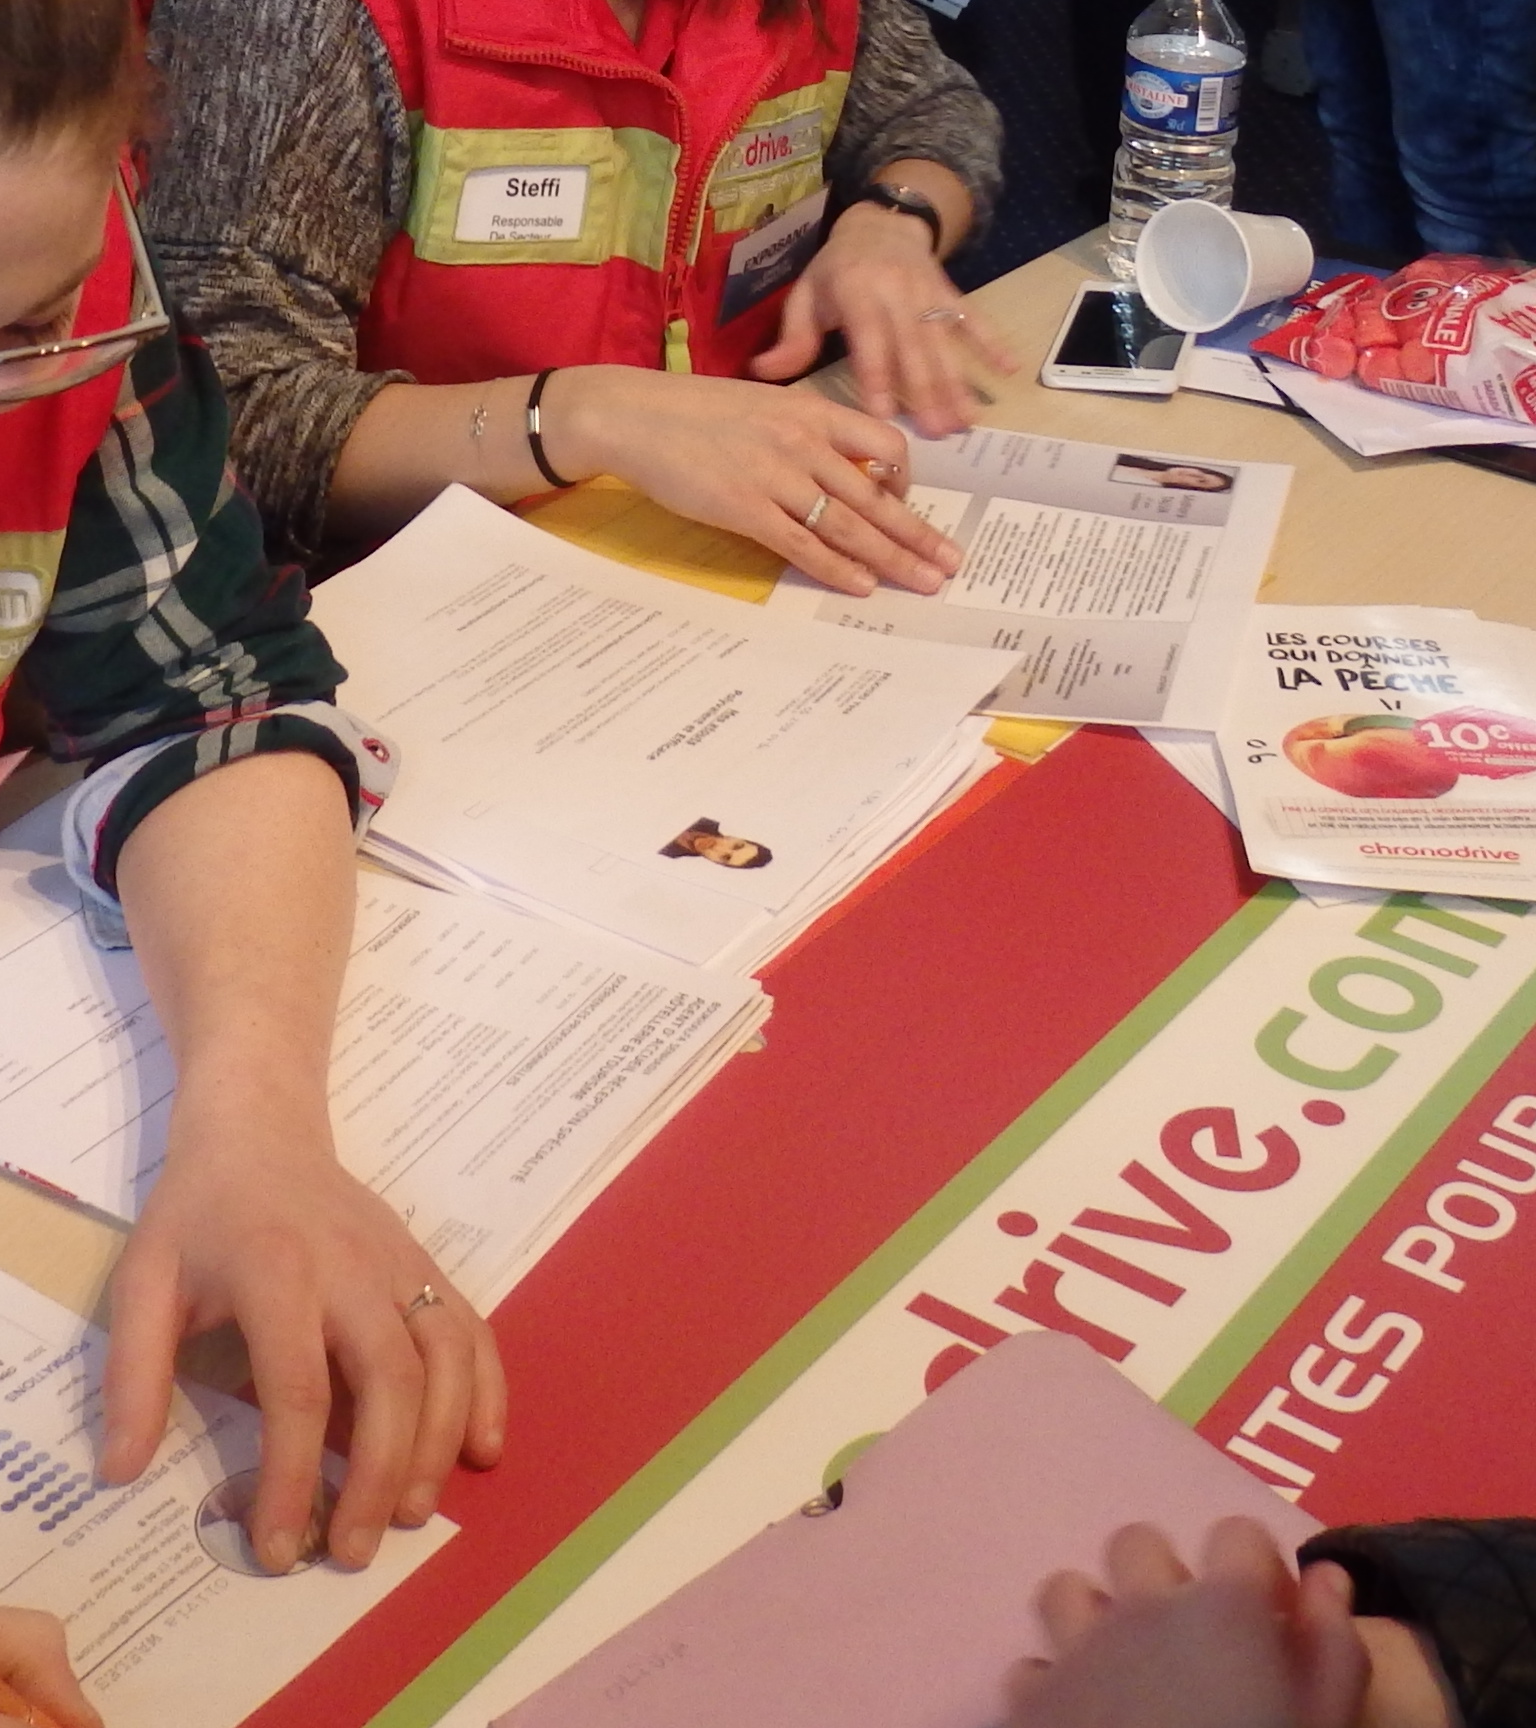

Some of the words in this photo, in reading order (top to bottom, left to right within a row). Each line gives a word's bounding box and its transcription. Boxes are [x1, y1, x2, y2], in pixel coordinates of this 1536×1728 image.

[1128, 82, 1184, 105] RISTALINE
[506, 177, 560, 197] Steffi
[491, 215, 563, 228] Responsable
[745, 222, 810, 272] EXPOSANT
[1266, 632, 1307, 646] LES
[1317, 635, 1441, 652] COURSES
[1268, 648, 1315, 662] QUI
[1327, 650, 1450, 668] DONNENT
[1276, 667, 1322, 690] LA
[1334, 661, 1464, 695] PÊCHE
[1359, 842, 1520, 860] chronodrive
[1226, 1294, 1424, 1503] ITES
